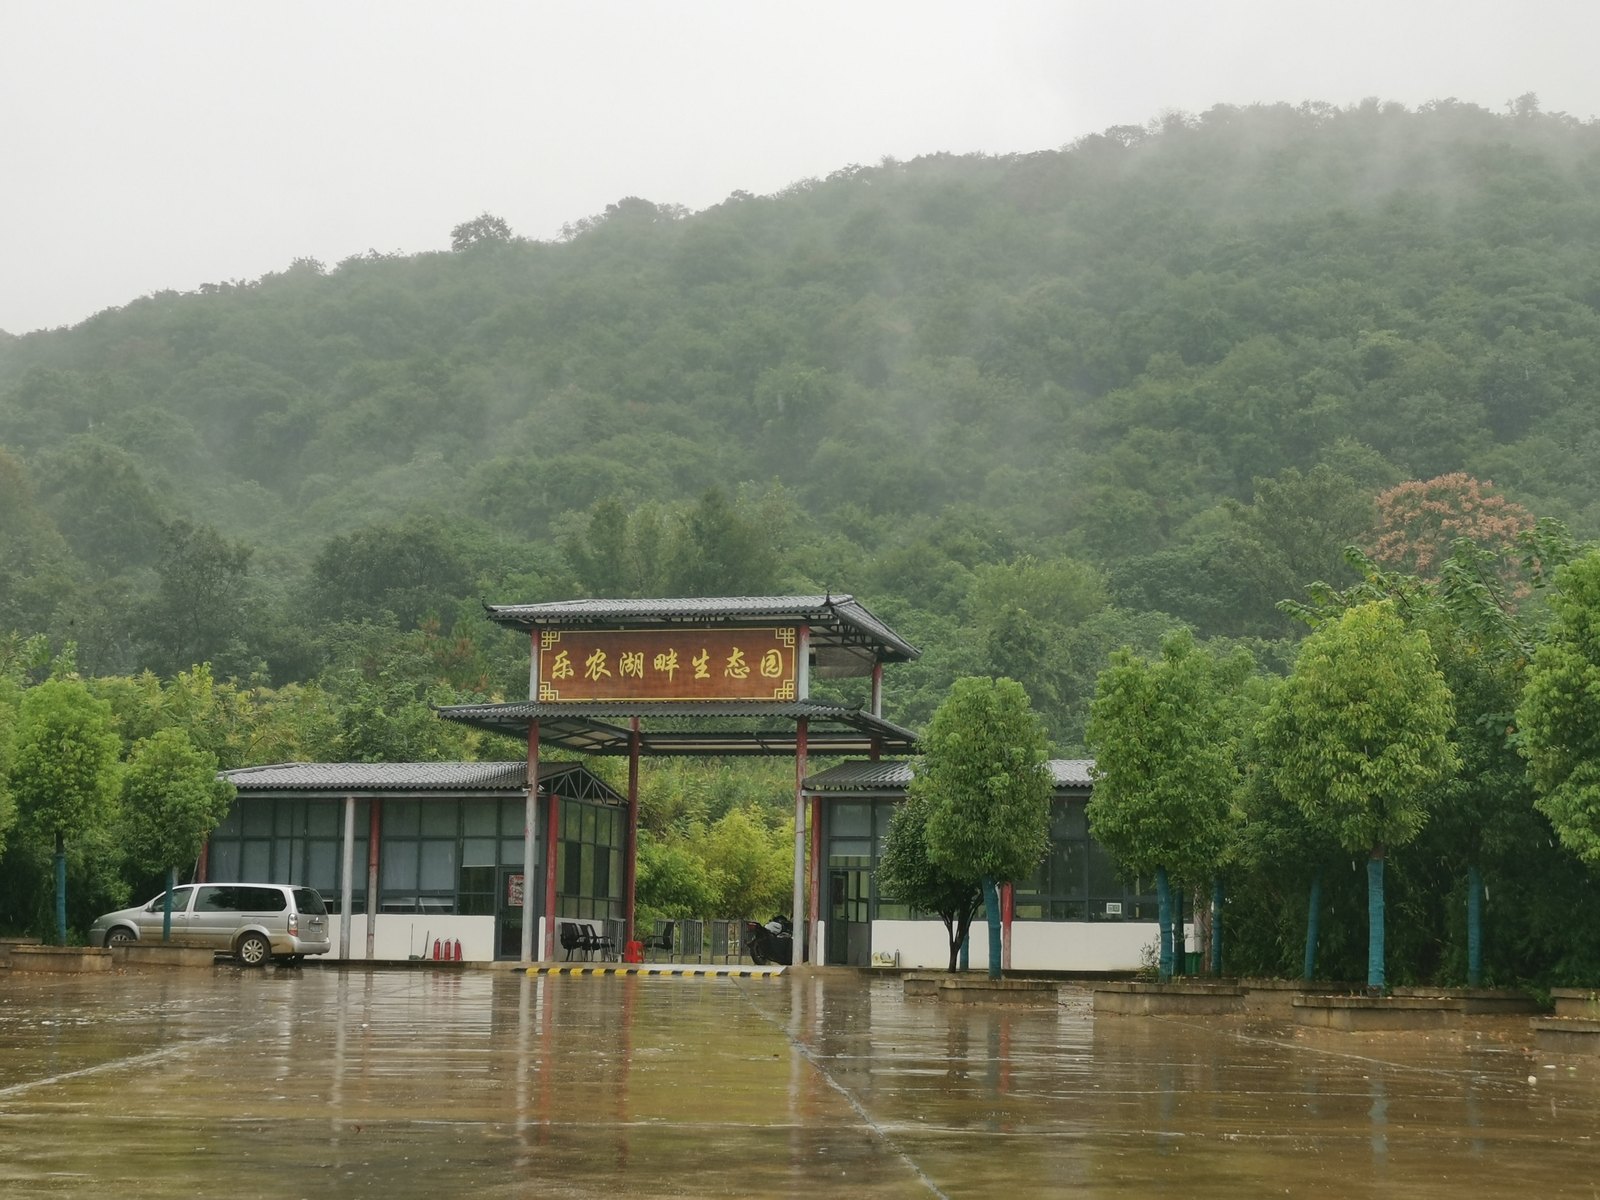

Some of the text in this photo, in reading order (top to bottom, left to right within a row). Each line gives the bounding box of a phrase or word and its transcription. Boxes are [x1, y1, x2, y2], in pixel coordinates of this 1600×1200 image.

[551, 646, 783, 683] 乐农湖畔生态园
